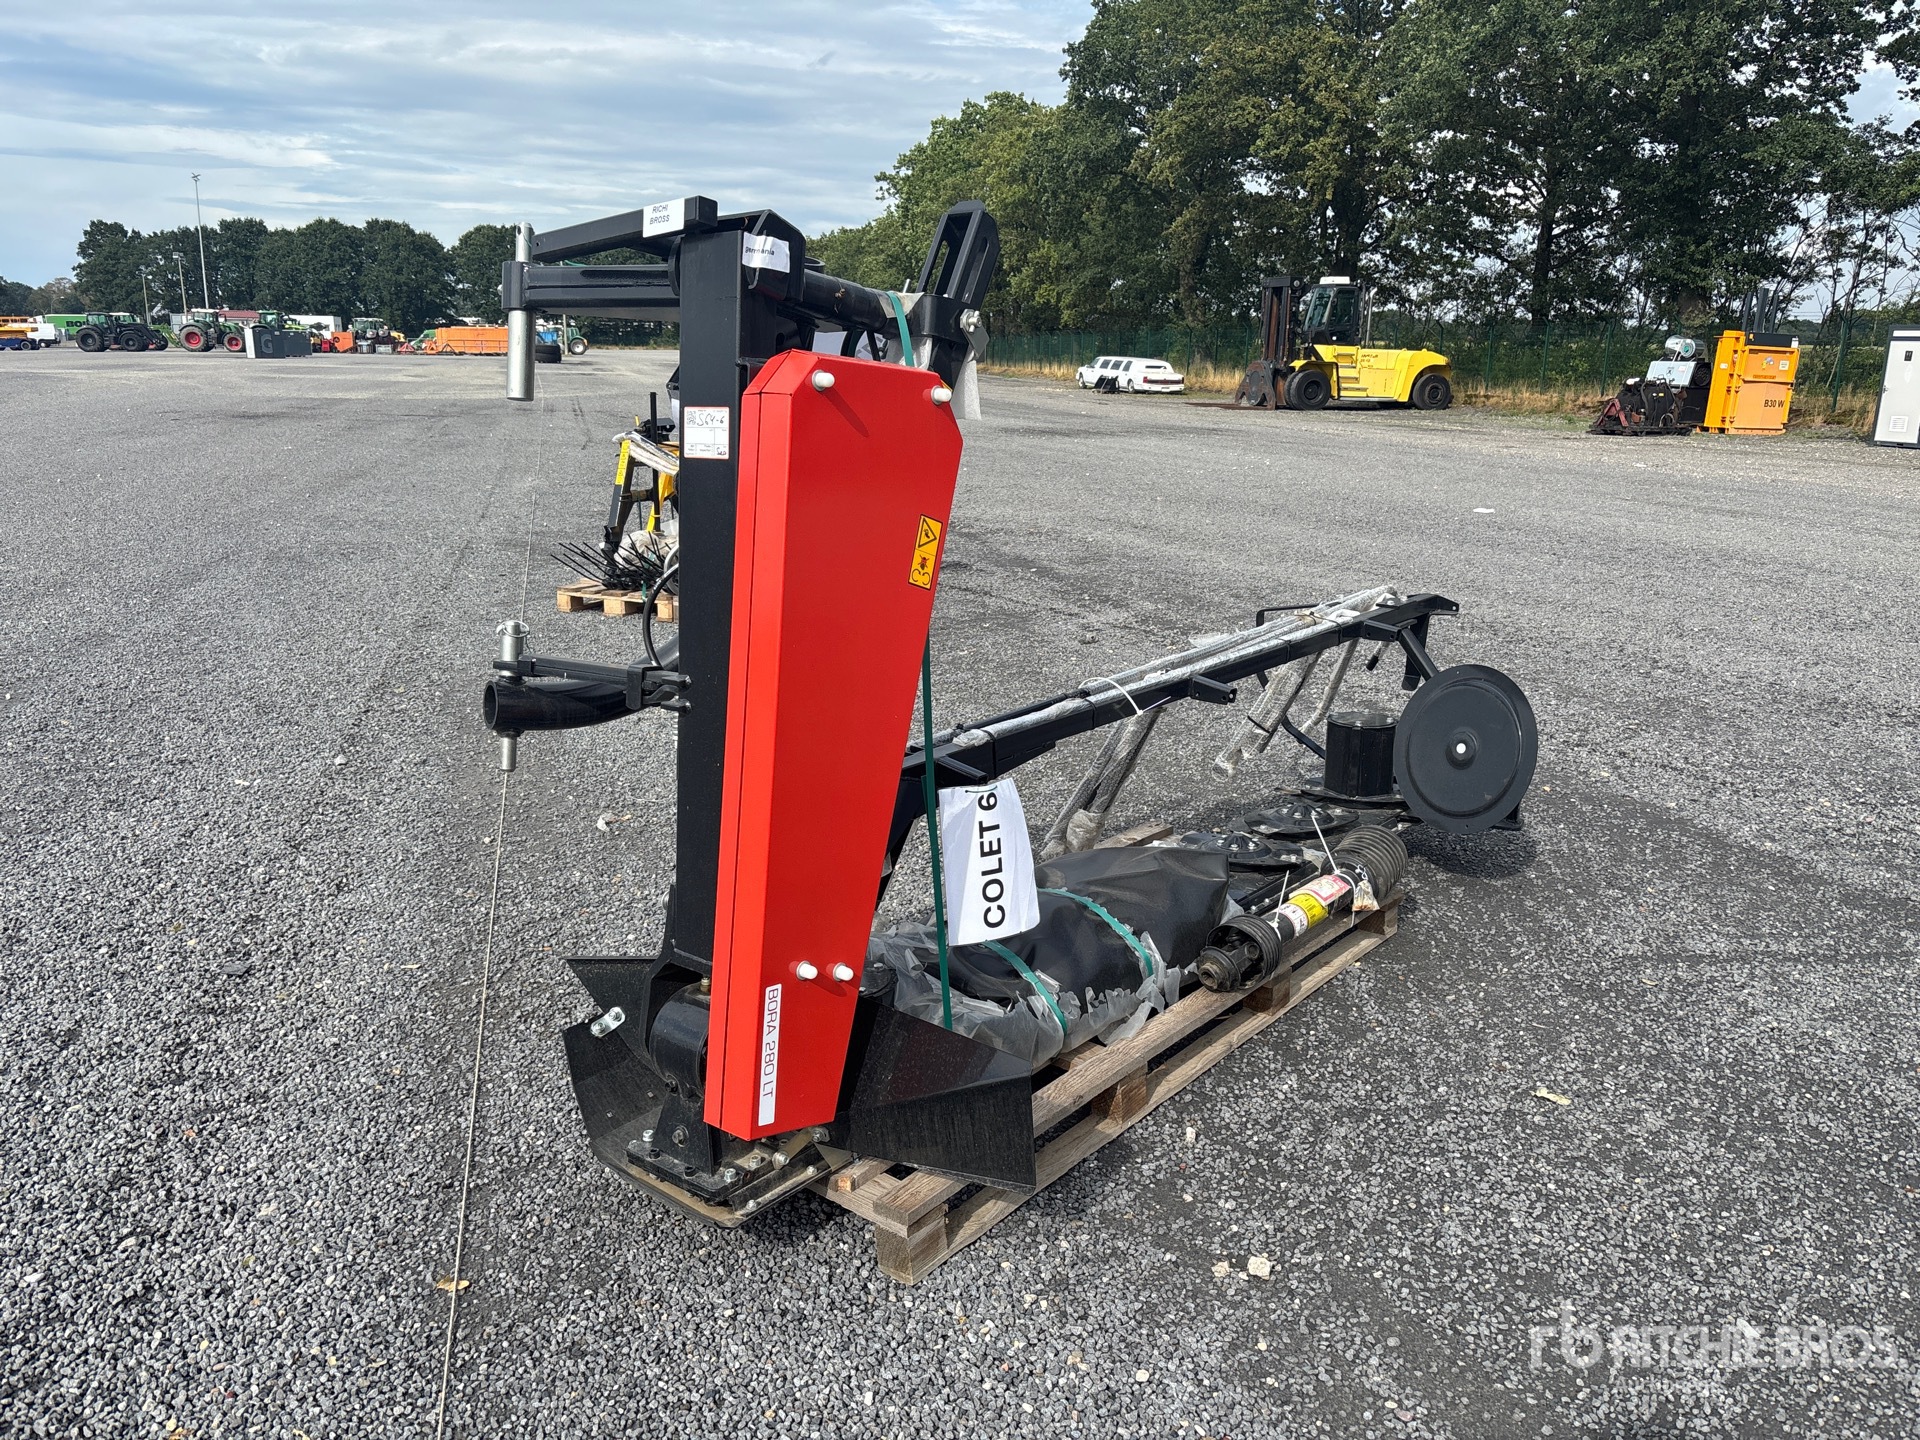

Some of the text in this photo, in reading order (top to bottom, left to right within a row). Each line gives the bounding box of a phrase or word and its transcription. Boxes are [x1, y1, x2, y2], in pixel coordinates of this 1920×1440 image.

[650, 215, 670, 225] BROSS
[1763, 399, 1785, 408] B30 W
[977, 792, 1006, 929] COLET 6
[763, 988, 779, 1098] BORA 280 LT
